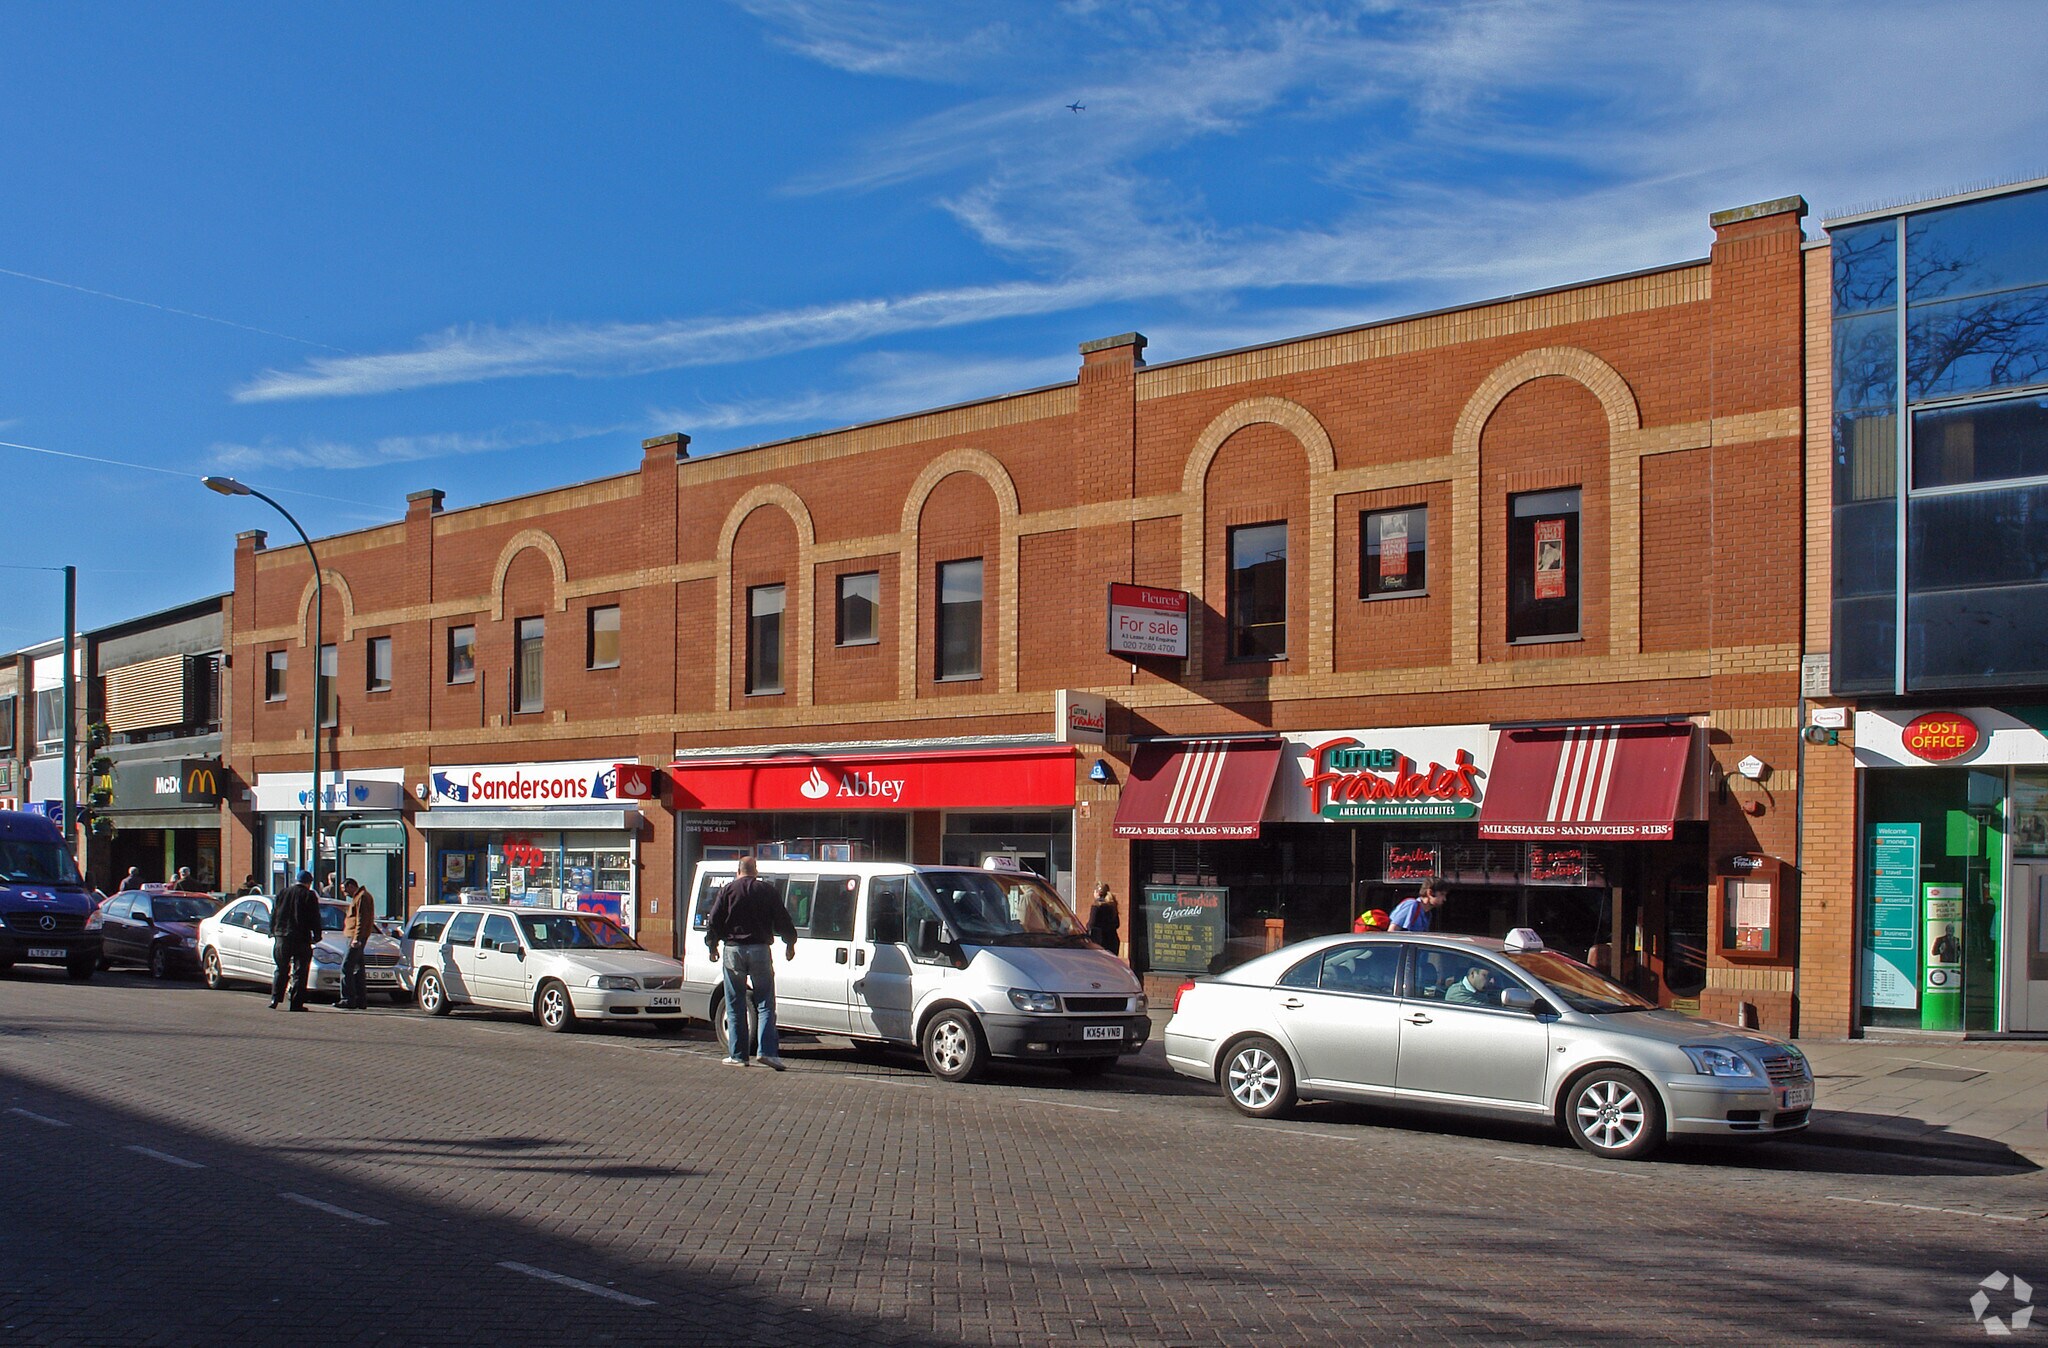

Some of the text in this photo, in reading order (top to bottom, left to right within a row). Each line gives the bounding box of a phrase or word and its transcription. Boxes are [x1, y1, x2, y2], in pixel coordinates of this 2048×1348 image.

[1141, 591, 1180, 606] Fleurets
[1119, 615, 1179, 636] For sale
[1122, 640, 1176, 653] 020 7280 4700
[1073, 707, 1088, 716] LITTLE
[1919, 721, 1961, 734] POST
[1911, 735, 1965, 748] OFFICE
[1330, 749, 1395, 768] LITTLE
[1303, 736, 1478, 814] Frankie's
[471, 771, 588, 800] Sandersons
[836, 771, 905, 803] Abbey
[1339, 806, 1456, 816] AMERICAN ITALIAN FAVOURITES
[1119, 826, 1253, 835] PIZZA BURGER SALADS WRAPS
[1483, 825, 1668, 835] MILKSHAKES SANDWICHES RIBS
[1886, 838, 1907, 846] money
[503, 836, 544, 876] 99p
[1152, 893, 1176, 901] LITTLE
[1162, 905, 1203, 923] Specials
[653, 997, 672, 1005] S404
[1087, 1028, 1105, 1037] KX54
